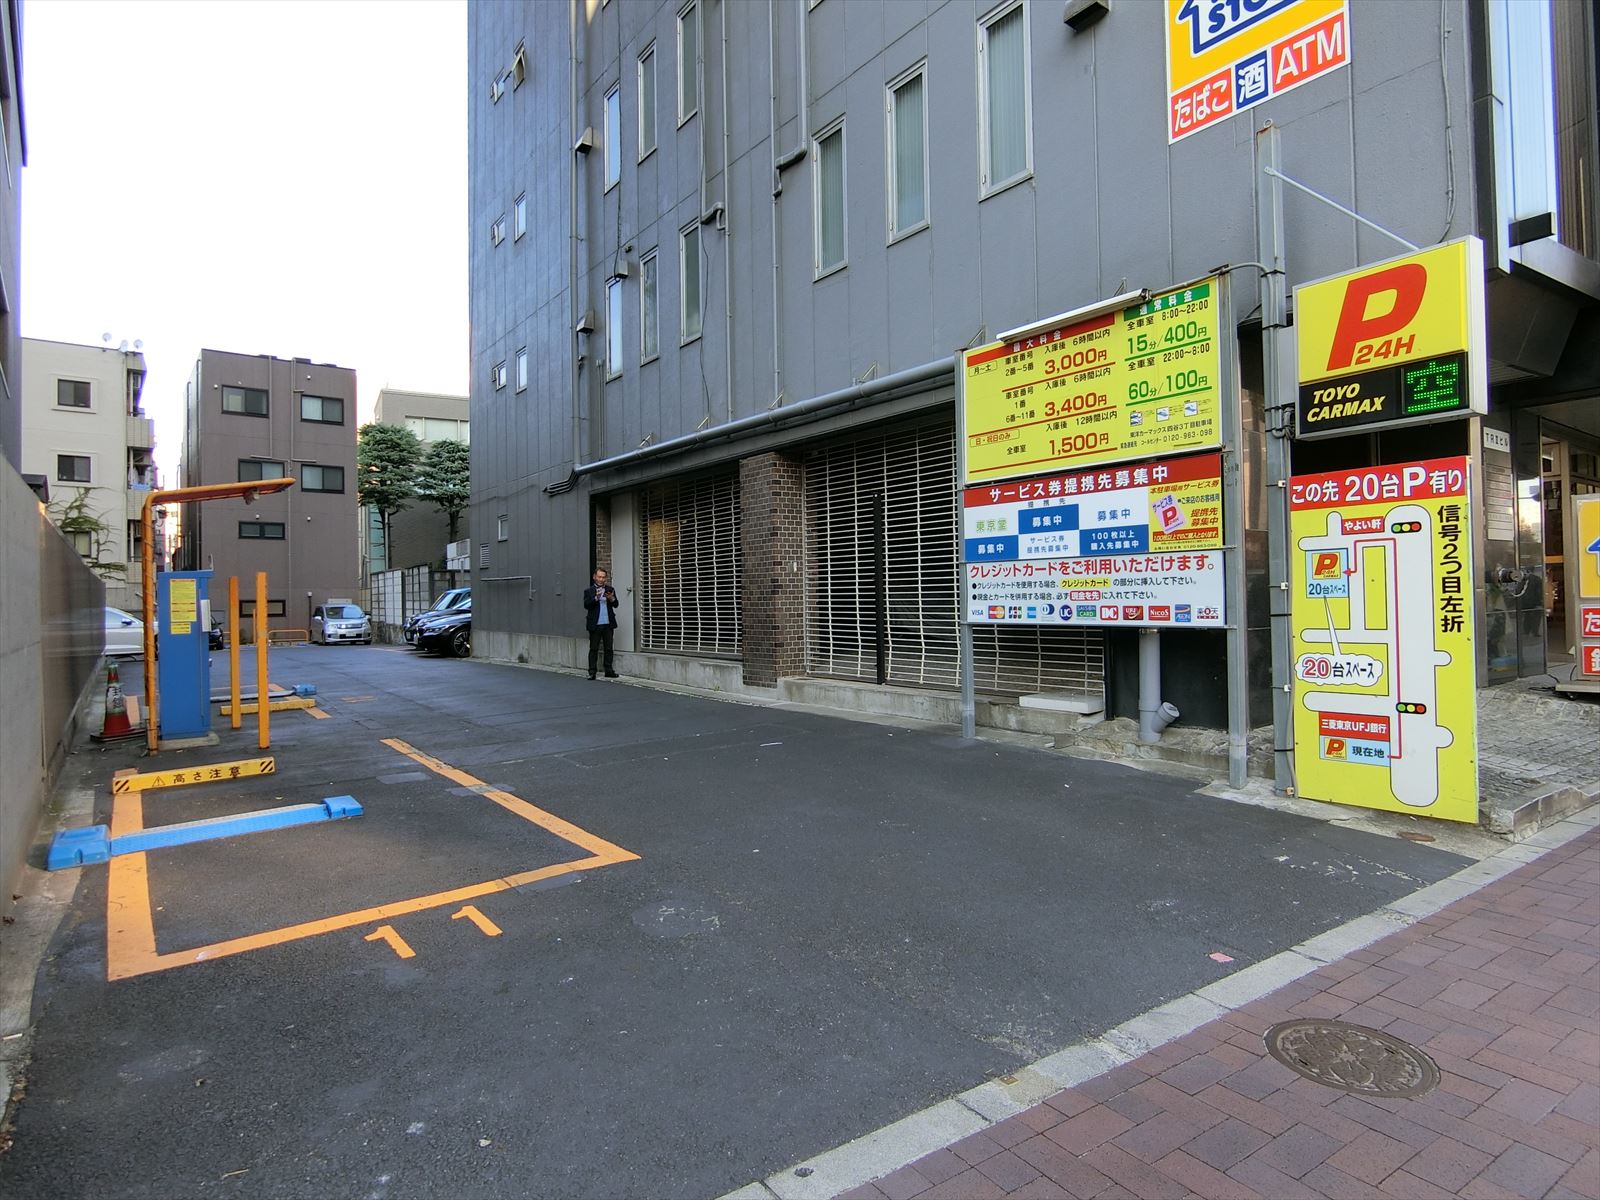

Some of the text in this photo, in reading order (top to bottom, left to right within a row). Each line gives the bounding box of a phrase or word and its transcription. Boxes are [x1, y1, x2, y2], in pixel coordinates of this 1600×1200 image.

[1276, 21, 1342, 84] ATM
[1238, 58, 1266, 103] 酒
[1174, 79, 1229, 132] たばこ
[1127, 316, 1154, 331] 全車室
[1327, 263, 1427, 371] P
[1005, 328, 1110, 364] 車室番号 入庫後 6時間以内
[1355, 334, 1416, 365] 24H
[1044, 348, 1107, 375] 3,000円
[1128, 357, 1155, 371] 全車室
[1005, 367, 1111, 400] 車室番号 入庫後 6時間以内
[1313, 383, 1361, 405] TOYO
[1407, 361, 1459, 412] 空
[1044, 392, 1107, 417] 3,400円
[1306, 396, 1385, 422] CARMAX
[1046, 420, 1067, 432] 入庫後
[1076, 410, 1118, 425] 12時間以内
[1006, 432, 1109, 455] 全車室 1,500円
[989, 465, 1168, 502] サービス券提携先募集中
[1291, 480, 1339, 503] この先
[1028, 498, 1066, 508] 提携先
[1191, 507, 1218, 517] 提携先
[1032, 515, 1062, 527] 募集中
[1097, 508, 1131, 521] 募集中
[1162, 506, 1177, 527] P
[1191, 517, 1218, 527] 募集中
[1344, 518, 1382, 531] やよい軒
[976, 519, 1008, 532] 東京堂
[977, 543, 1005, 555] 募集中
[1027, 544, 1069, 554] 提携先募集中
[1030, 535, 1065, 543] サービス券
[1090, 540, 1139, 551] 購入先募集中
[970, 554, 1214, 578] クレジットカードをご利用いただけます。
[1315, 553, 1338, 575] P
[1437, 504, 1465, 633] 信号2つ目左折
[1060, 608, 1073, 617] UC
[1303, 658, 1375, 679] 20台スペース
[1321, 719, 1386, 734] 三菱東京UFJ銀行
[1326, 738, 1345, 755] P
[1352, 746, 1385, 758] 現在地
[173, 766, 241, 784] 高さ注意
